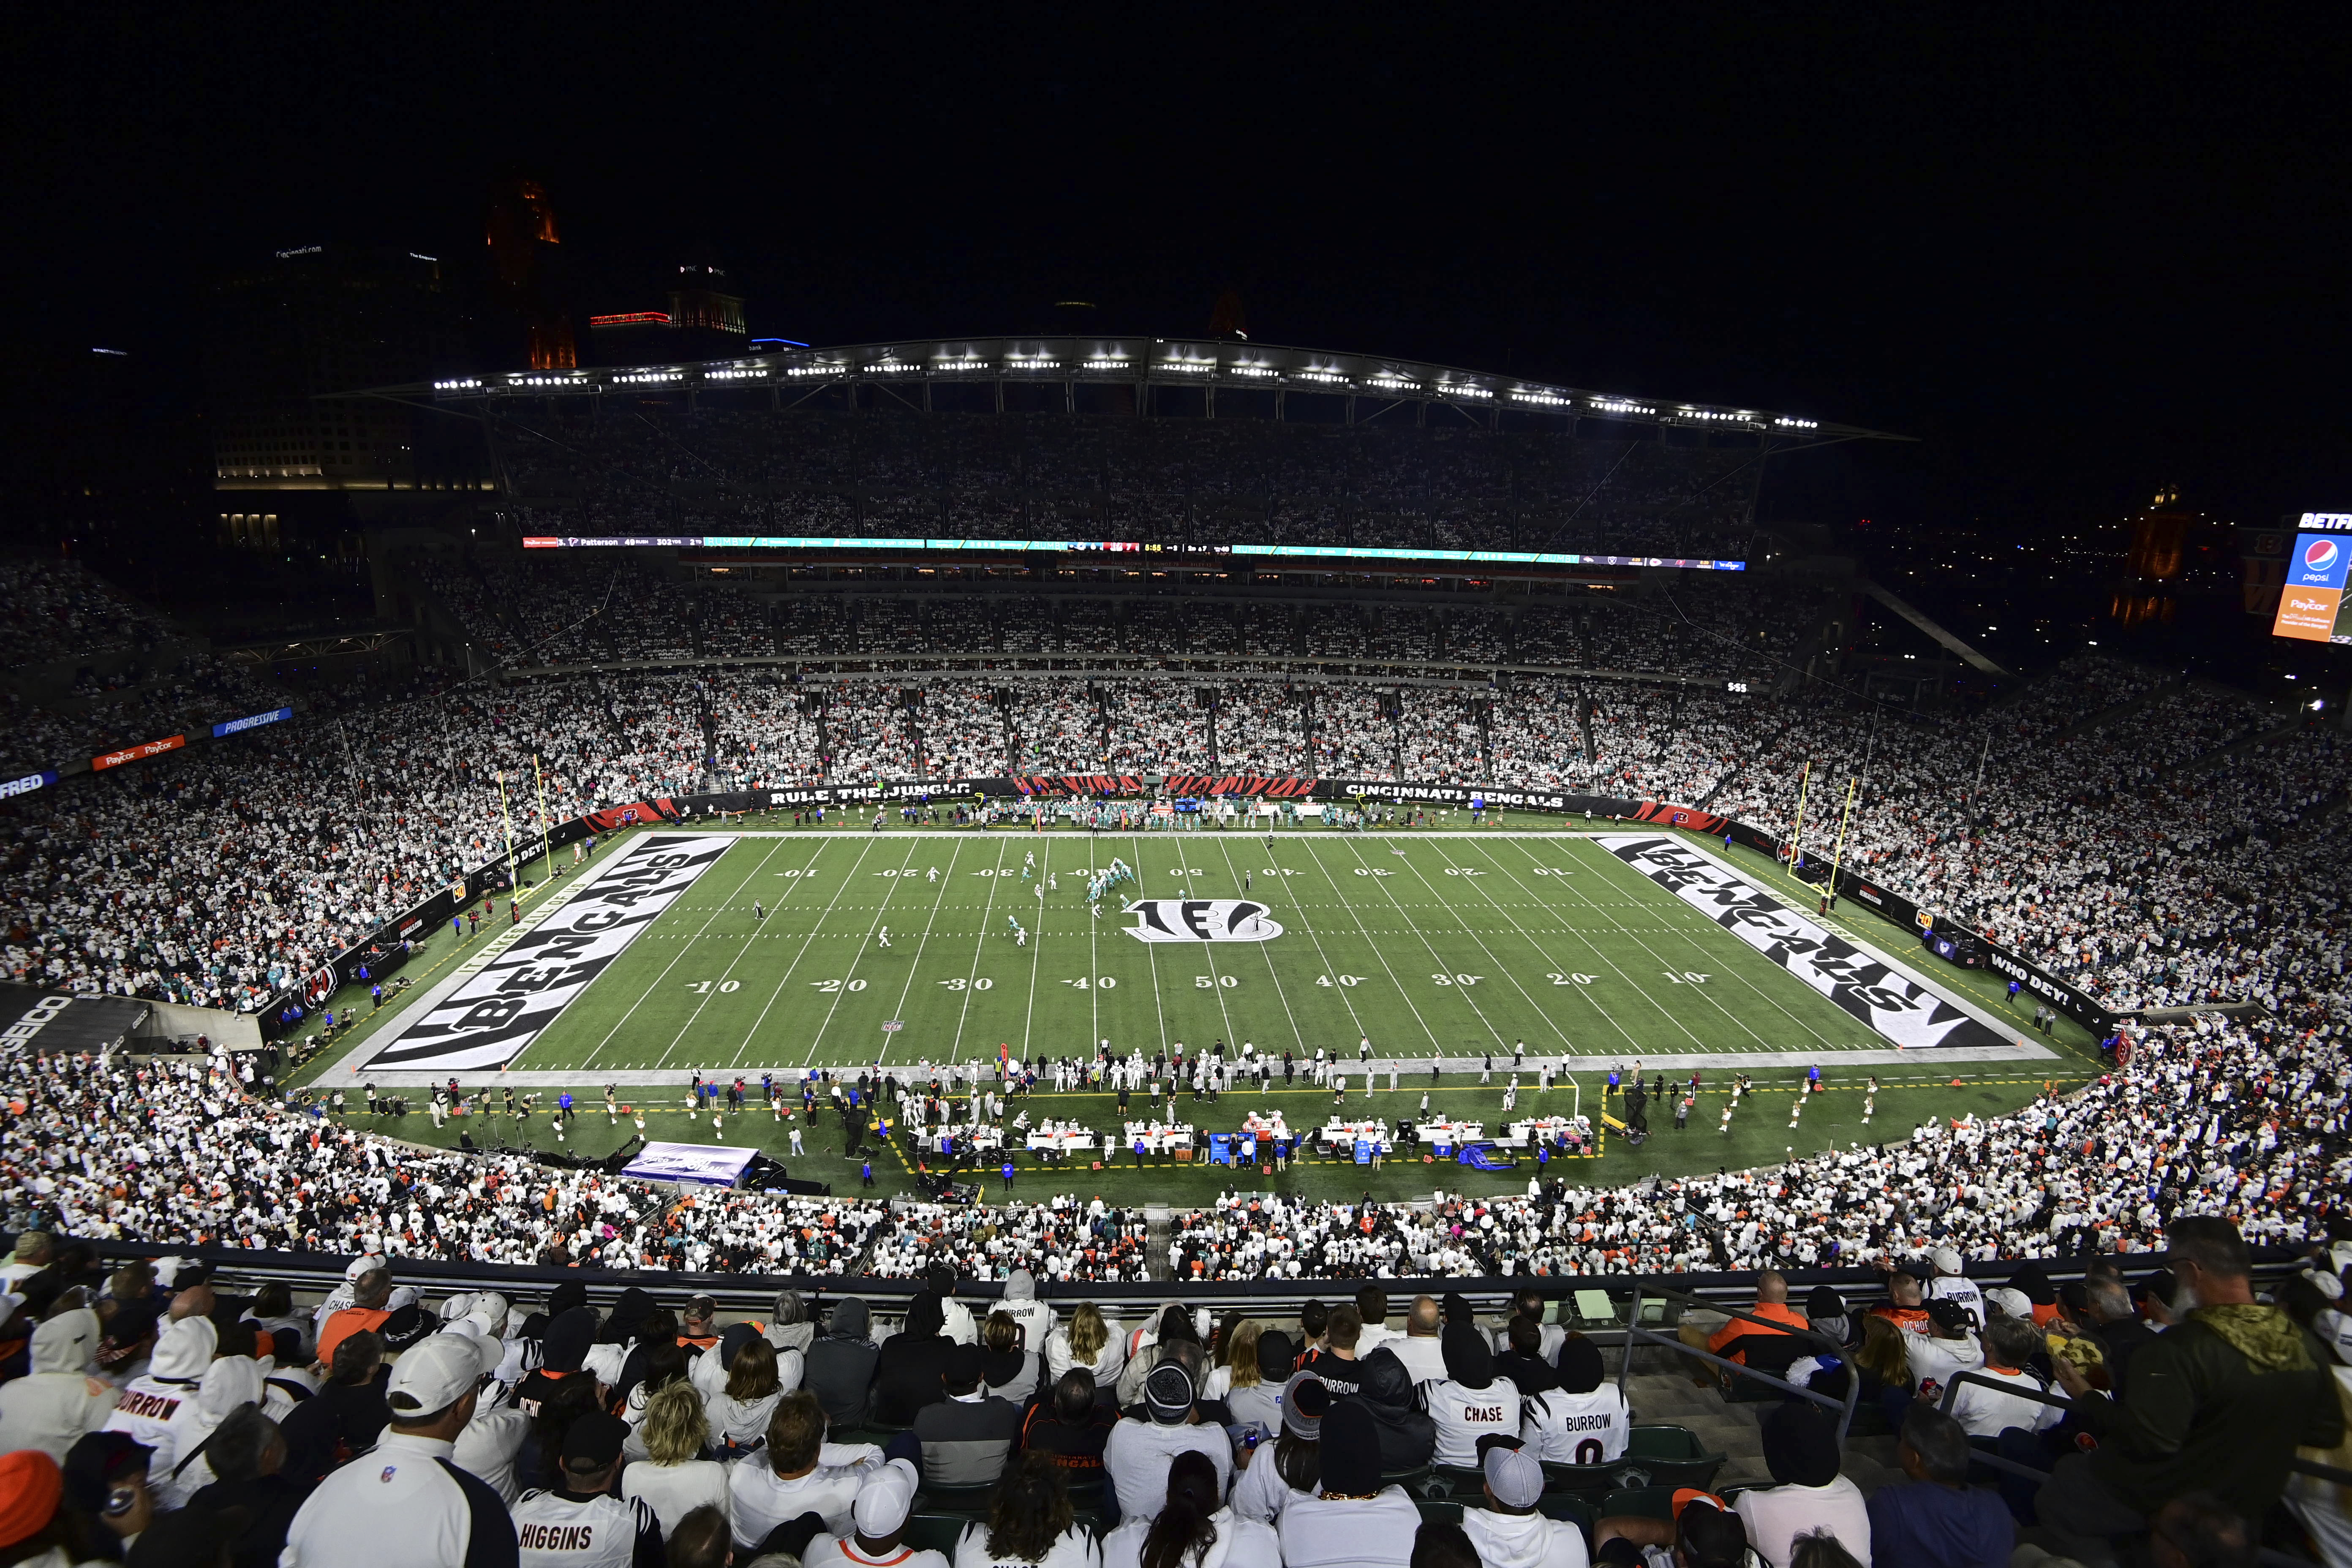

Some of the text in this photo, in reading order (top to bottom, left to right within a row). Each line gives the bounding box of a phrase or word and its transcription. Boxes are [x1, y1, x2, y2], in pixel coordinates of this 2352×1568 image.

[708, 537, 745, 545] RUMBY
[1034, 542, 1066, 550] RUMBY
[1543, 554, 1577, 562] RUMBY
[2302, 574, 2329, 582] pepsi
[2291, 598, 2328, 611] Paycor
[1728, 682, 1747, 692] 5:55
[225, 710, 279, 733] PROGRESSIVE
[145, 741, 173, 755] Paycor
[106, 751, 136, 765] Paycor
[771, 790, 829, 805] RULE
[838, 787, 882, 800] THE
[1346, 784, 1563, 807] CINCINNATI BENGALS
[521, 841, 544, 861] DEY!
[784, 868, 819, 878] 10
[882, 868, 918, 878] 20
[979, 868, 1015, 878] 30
[1169, 868, 1203, 877] 50
[1262, 868, 1295, 877] 40
[1354, 868, 1387, 877] 30
[1444, 868, 1478, 877] 20
[1533, 868, 1565, 877] 10
[454, 885, 465, 899] 40
[1859, 889, 1882, 906] BENGALS.COM
[1768, 894, 1861, 942] END RACISM
[1918, 912, 1933, 927] 40
[400, 919, 422, 939] BENGALS.COM
[458, 883, 587, 972] IT TAKES ALL OF US
[1636, 850, 1922, 1013] BENGALS
[449, 853, 690, 1032] BENGALS
[946, 977, 993, 991] 30
[1072, 976, 1116, 990] 40
[1195, 975, 1239, 988] 50
[1315, 975, 1358, 988] 40
[1432, 973, 1476, 987] 30
[1546, 972, 1592, 985] 20
[1663, 971, 1707, 983] 10
[1991, 953, 2069, 1006] WHO DEY!
[693, 980, 740, 994] 10
[819, 979, 867, 992] 20
[0, 996, 73, 1053] GEICO
[133, 1009, 148, 1029] GEICO
[1946, 1290, 1979, 1303] BURROW
[1465, 1406, 1503, 1422] CHASE
[1566, 1413, 1611, 1432] BURROW
[520, 1523, 591, 1549] HIGGINS
